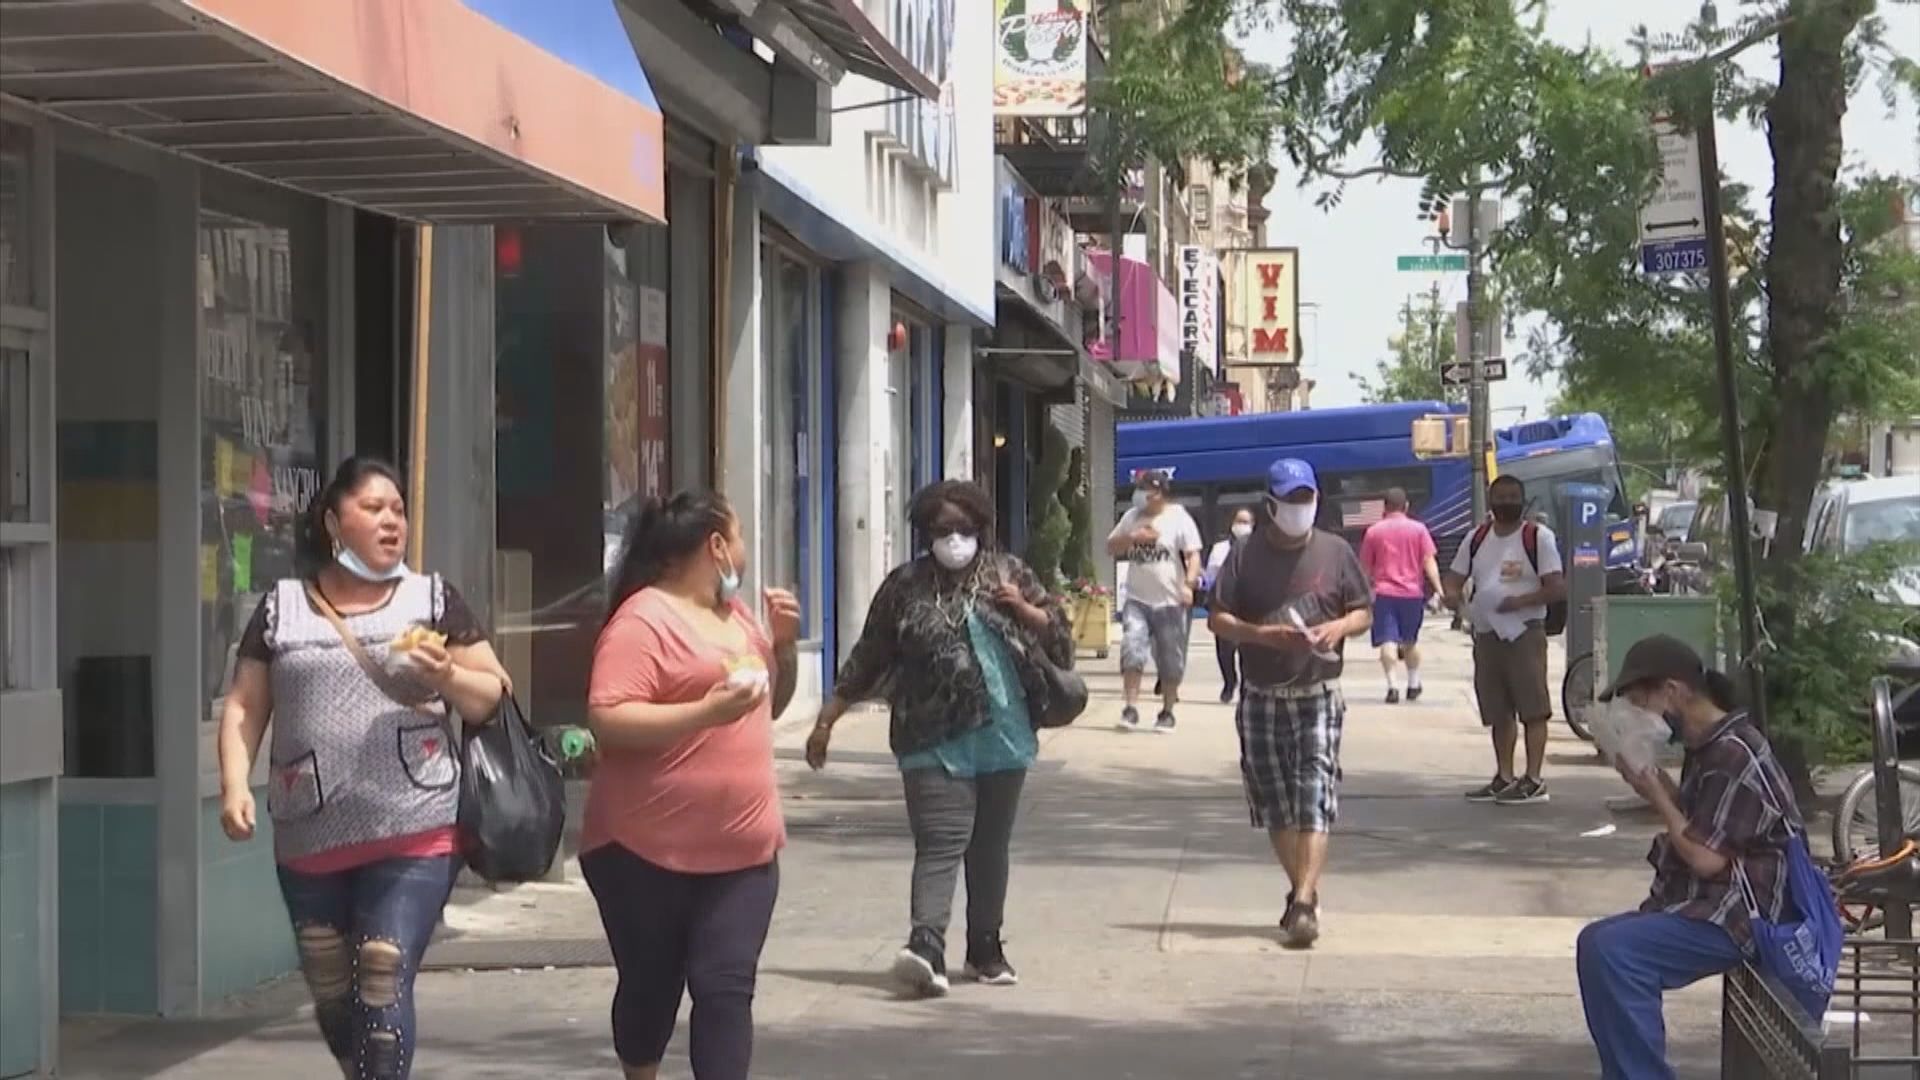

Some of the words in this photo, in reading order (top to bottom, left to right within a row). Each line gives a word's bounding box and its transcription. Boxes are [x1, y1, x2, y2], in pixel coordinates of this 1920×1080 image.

[1655, 249, 1706, 271] 307375
[1252, 263, 1289, 353] VIM
[1582, 502, 1597, 524] P
